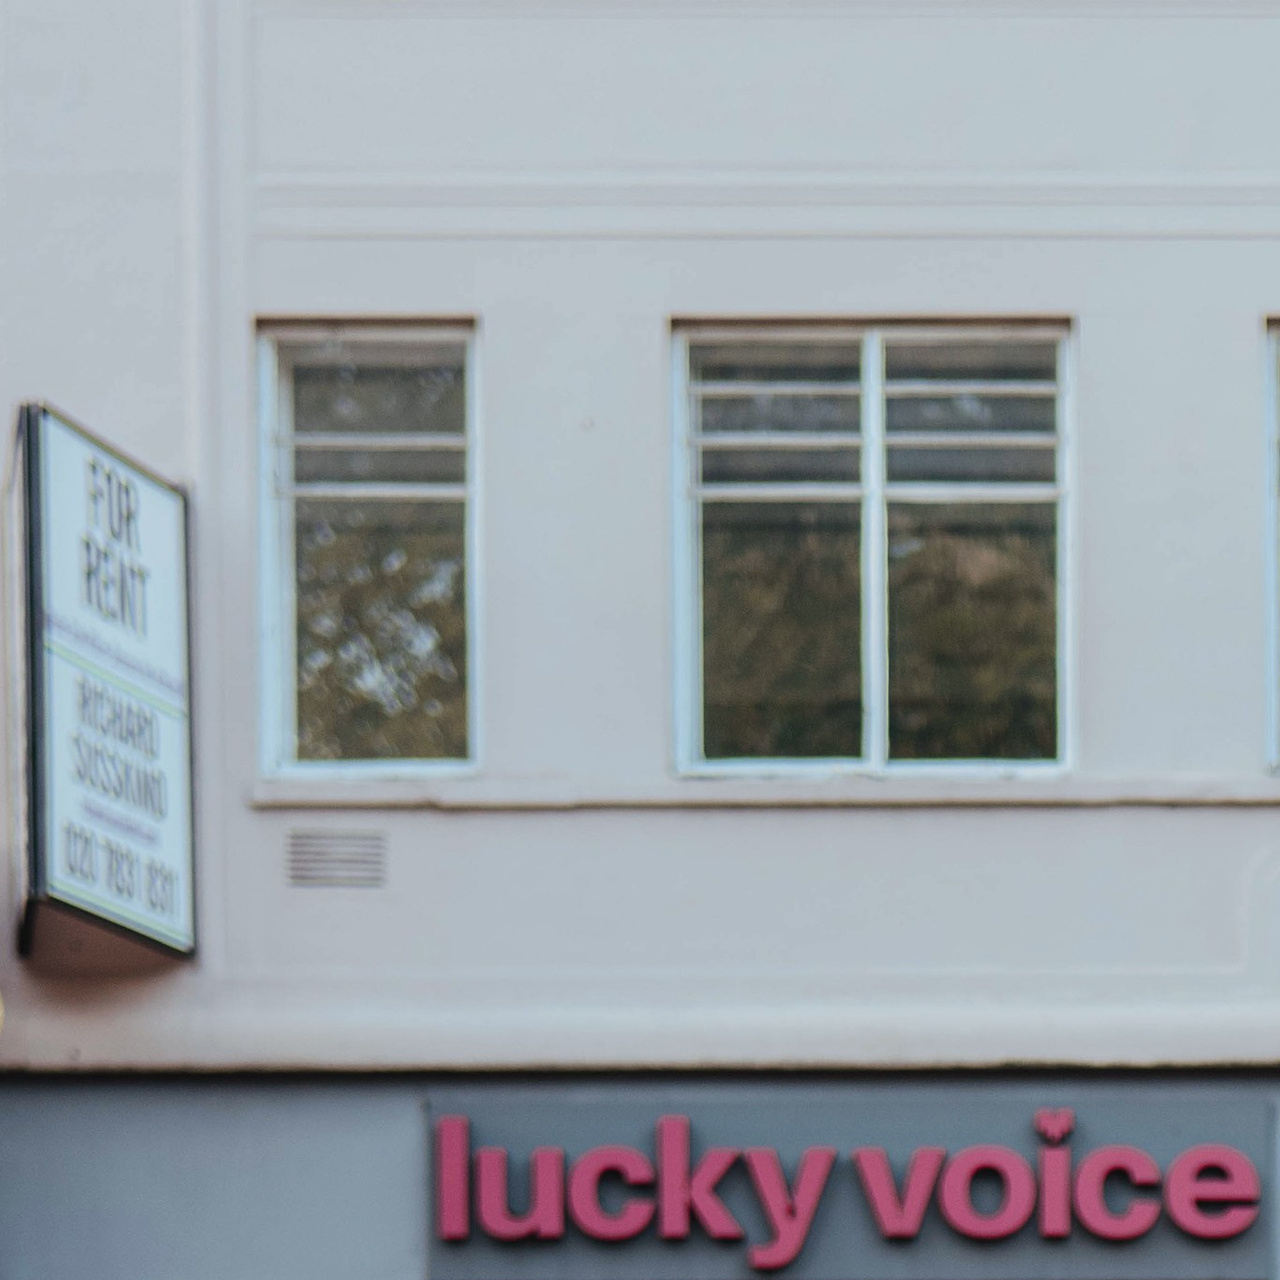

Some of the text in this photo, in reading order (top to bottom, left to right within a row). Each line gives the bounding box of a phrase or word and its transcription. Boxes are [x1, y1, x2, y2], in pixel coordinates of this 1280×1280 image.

[81, 532, 151, 637] RENT
[435, 1107, 1261, 1271] lucky voice
